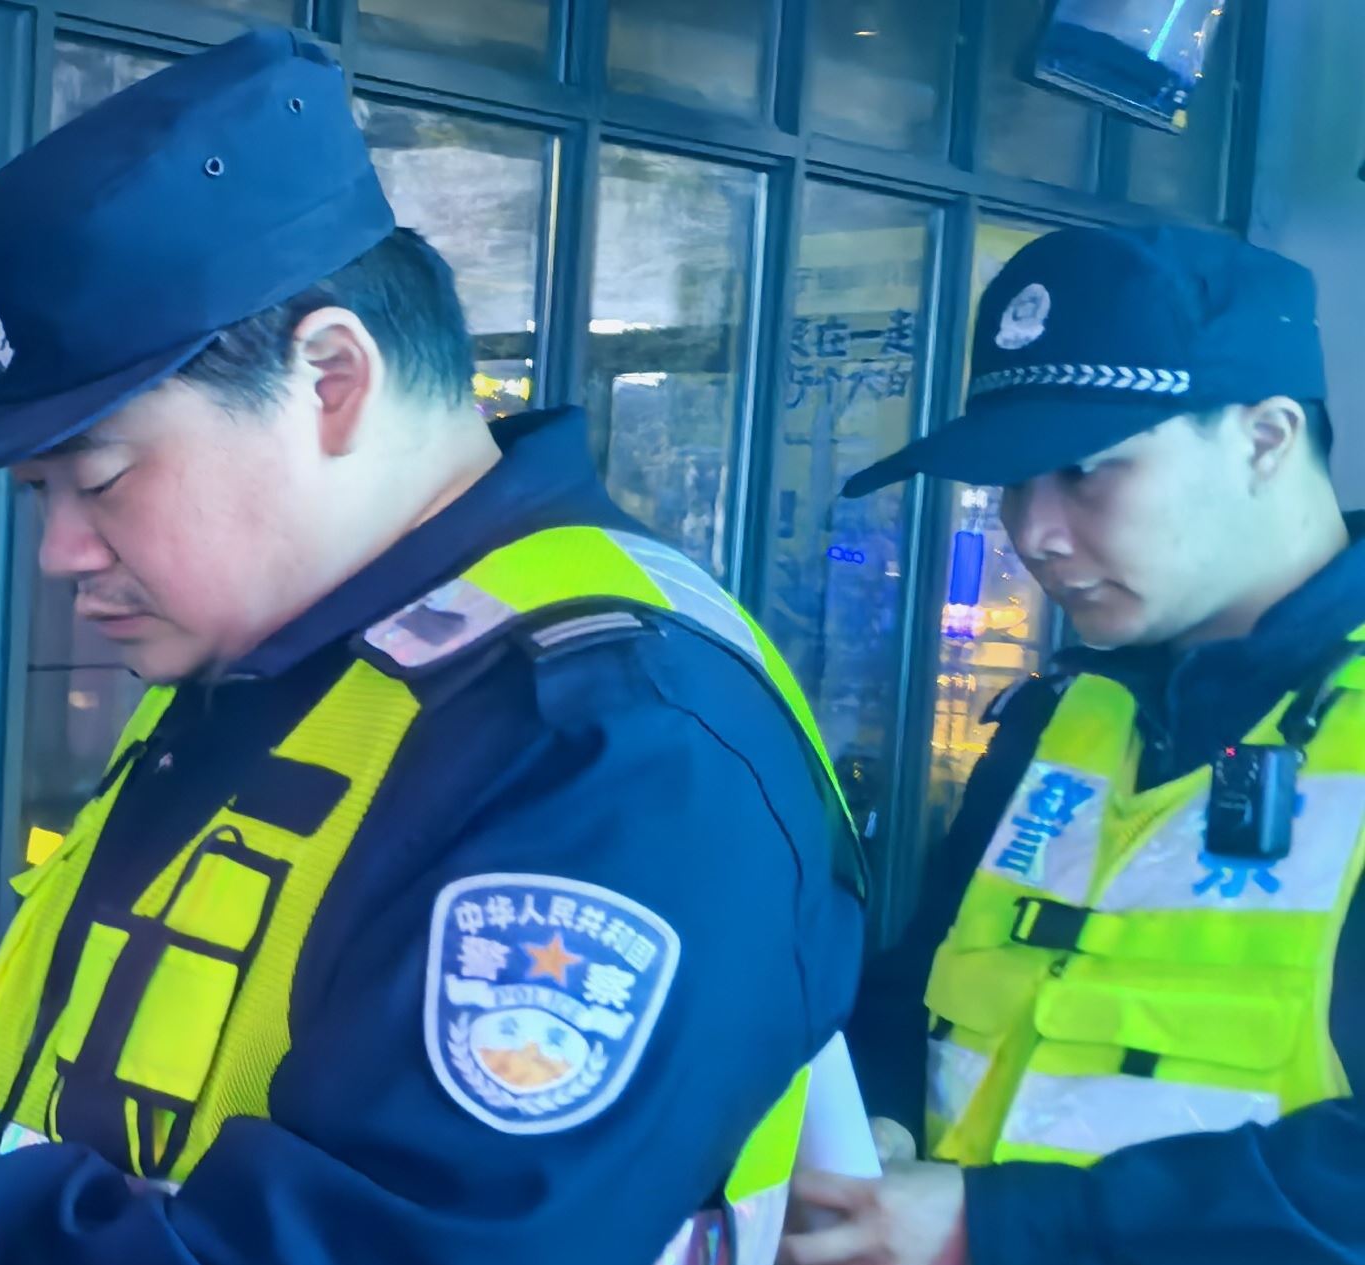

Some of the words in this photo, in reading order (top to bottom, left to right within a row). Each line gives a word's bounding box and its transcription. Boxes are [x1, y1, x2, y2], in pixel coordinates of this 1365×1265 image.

[454, 893, 657, 974] 中华人民共和国
